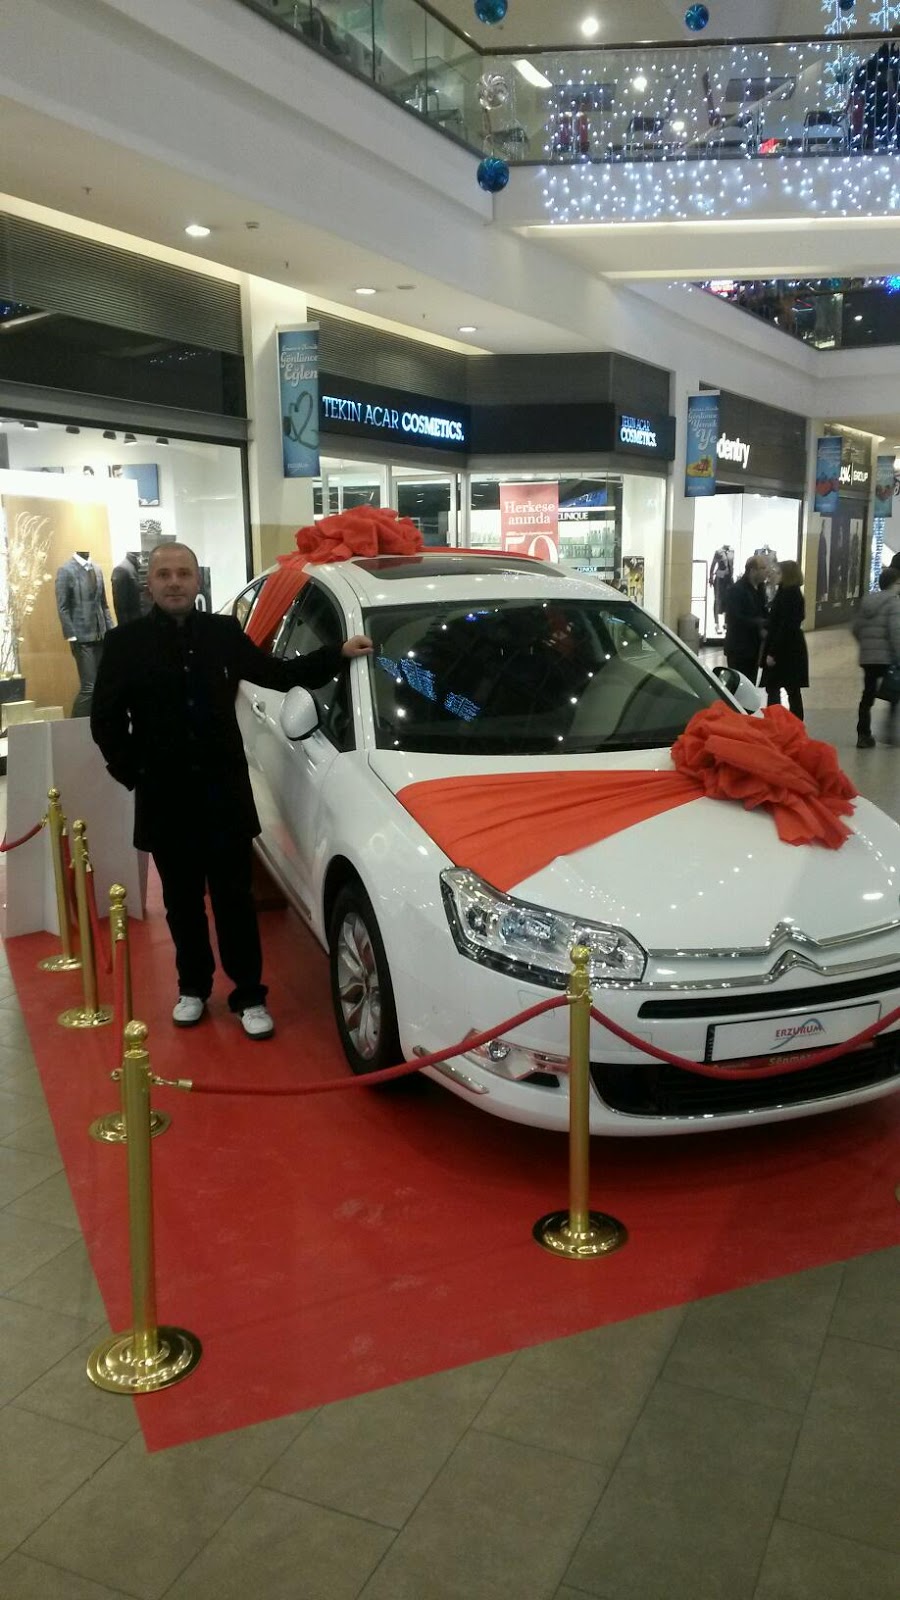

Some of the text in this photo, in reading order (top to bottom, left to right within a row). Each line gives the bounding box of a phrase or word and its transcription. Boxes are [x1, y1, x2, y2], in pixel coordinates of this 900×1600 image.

[284, 362, 319, 388] Eğlen
[322, 395, 362, 422] TEKIN
[364, 404, 399, 429] ACAR
[504, 500, 555, 513] Herkese
[508, 511, 551, 525] anında
[775, 1025, 823, 1037] ERZURUM
